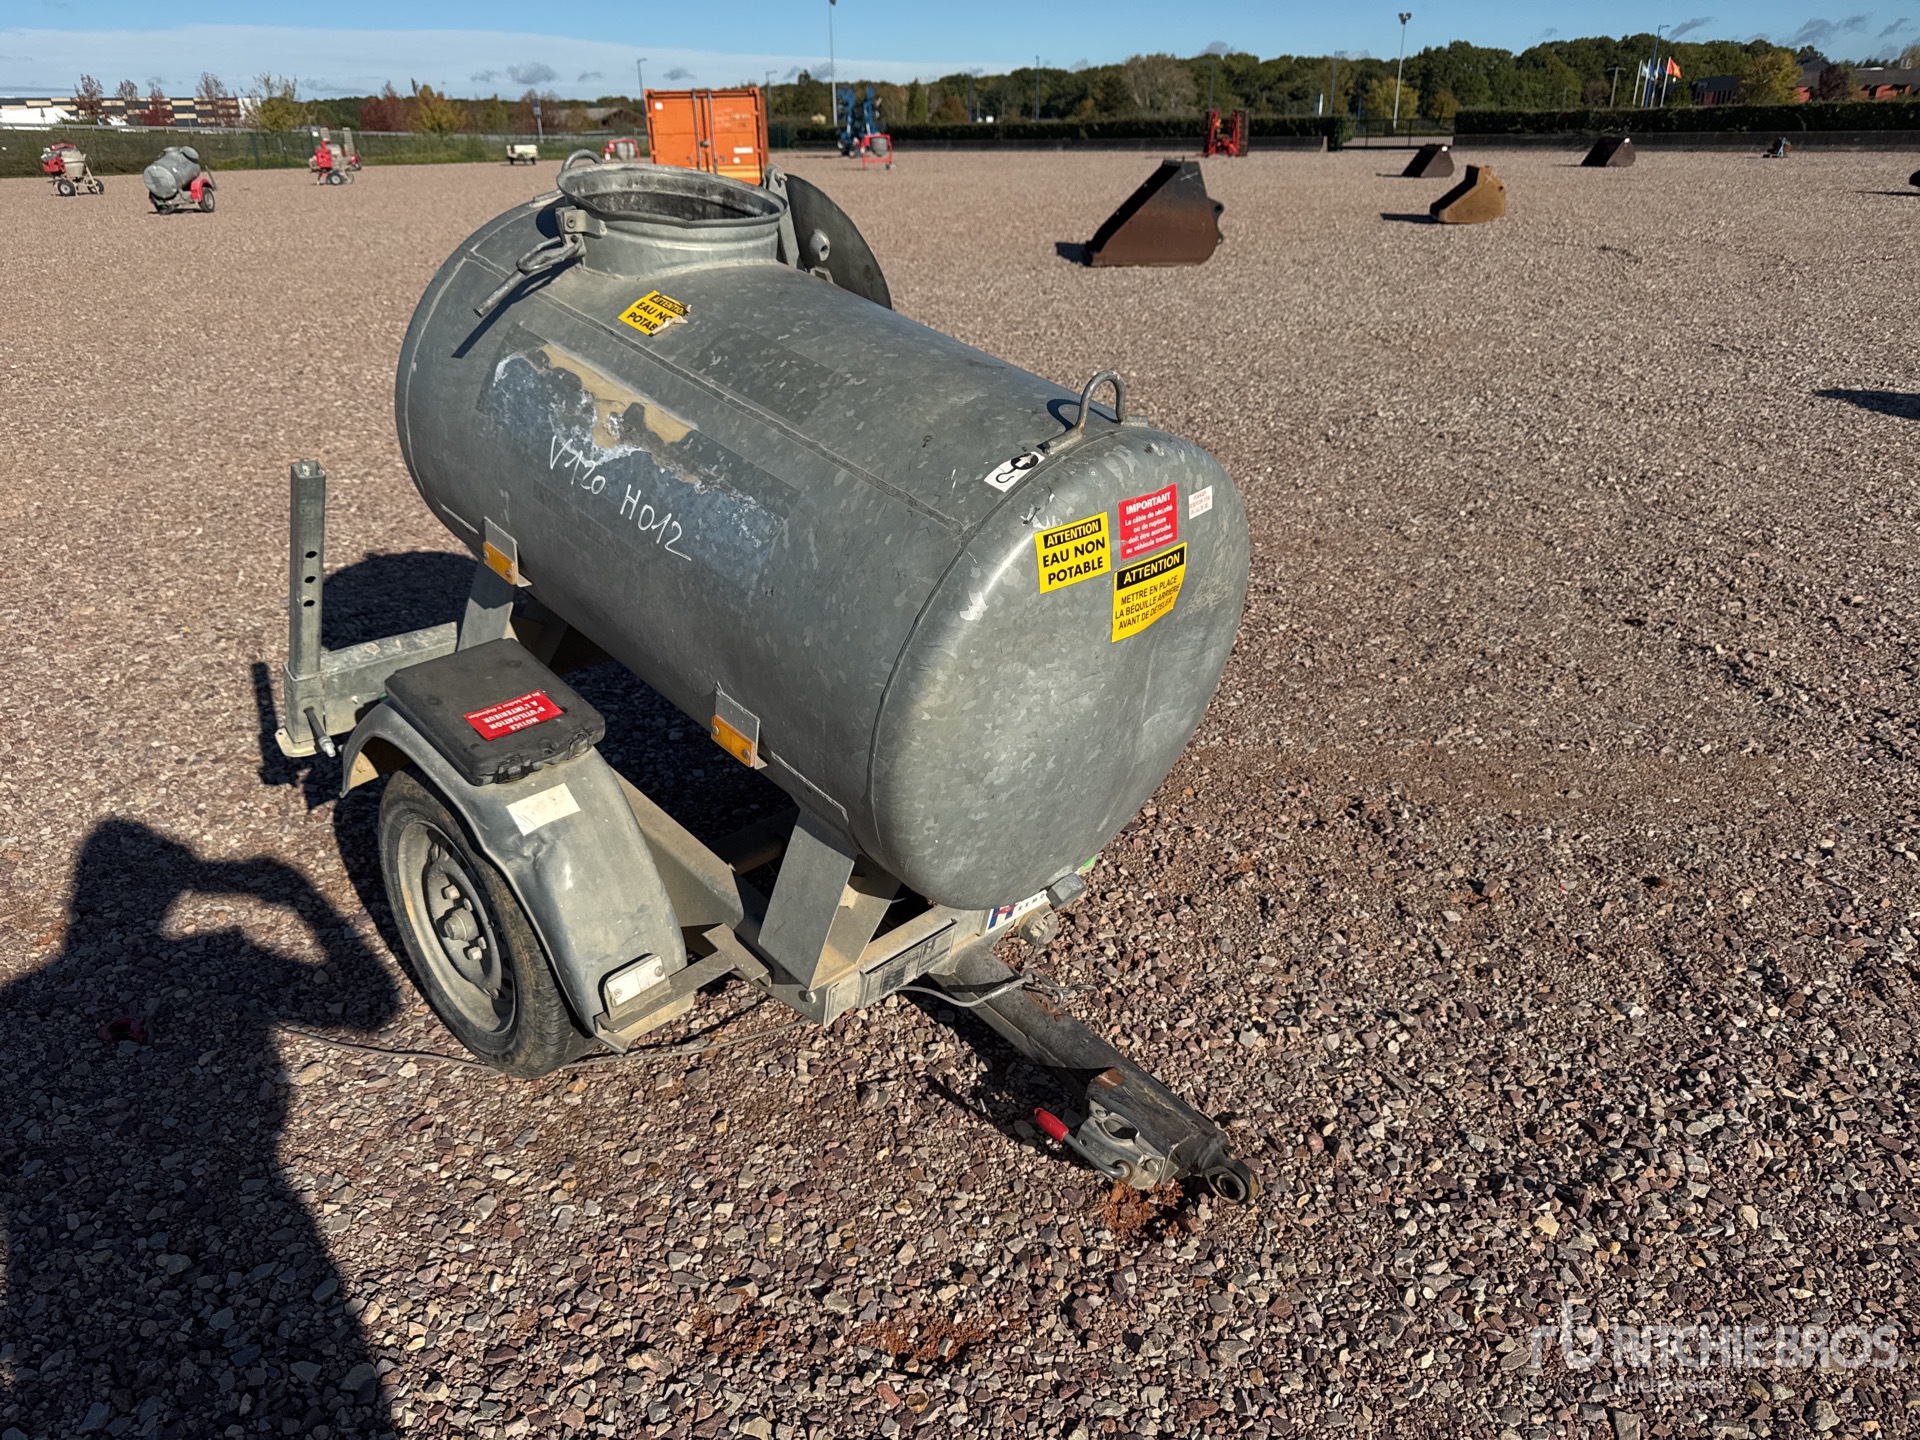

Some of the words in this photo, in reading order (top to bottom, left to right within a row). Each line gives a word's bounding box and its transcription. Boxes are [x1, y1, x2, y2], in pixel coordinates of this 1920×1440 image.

[626, 312, 658, 331] POTAB
[636, 302, 658, 315] EAU
[654, 311, 673, 323] NO
[550, 435, 606, 494] V120
[1126, 491, 1171, 515] IMPORTANT
[1132, 514, 1146, 523] câble
[1147, 511, 1154, 519] de
[1155, 503, 1173, 516] sécurité
[1149, 517, 1166, 527] rupture
[1047, 520, 1099, 547] ATTENTION
[1128, 535, 1139, 544] doit
[1140, 532, 1150, 540] être
[1151, 523, 1171, 536] accroché
[1134, 540, 1155, 551] véhicule
[1155, 532, 1173, 543] tracteur
[1042, 548, 1069, 568] EAU
[1074, 536, 1105, 558] NON
[1048, 556, 1103, 585] POTABLE
[1123, 552, 1180, 585] ATTENTION
[1121, 588, 1148, 605] METTRE
[1149, 584, 1158, 595] EN
[1159, 574, 1178, 590] PLACE
[1115, 609, 1124, 619] LA
[1118, 615, 1140, 630] AVANT
[1141, 610, 1149, 621] DE
[489, 706, 546, 730] D'UTILISATION
[509, 716, 539, 730] NOTICE
